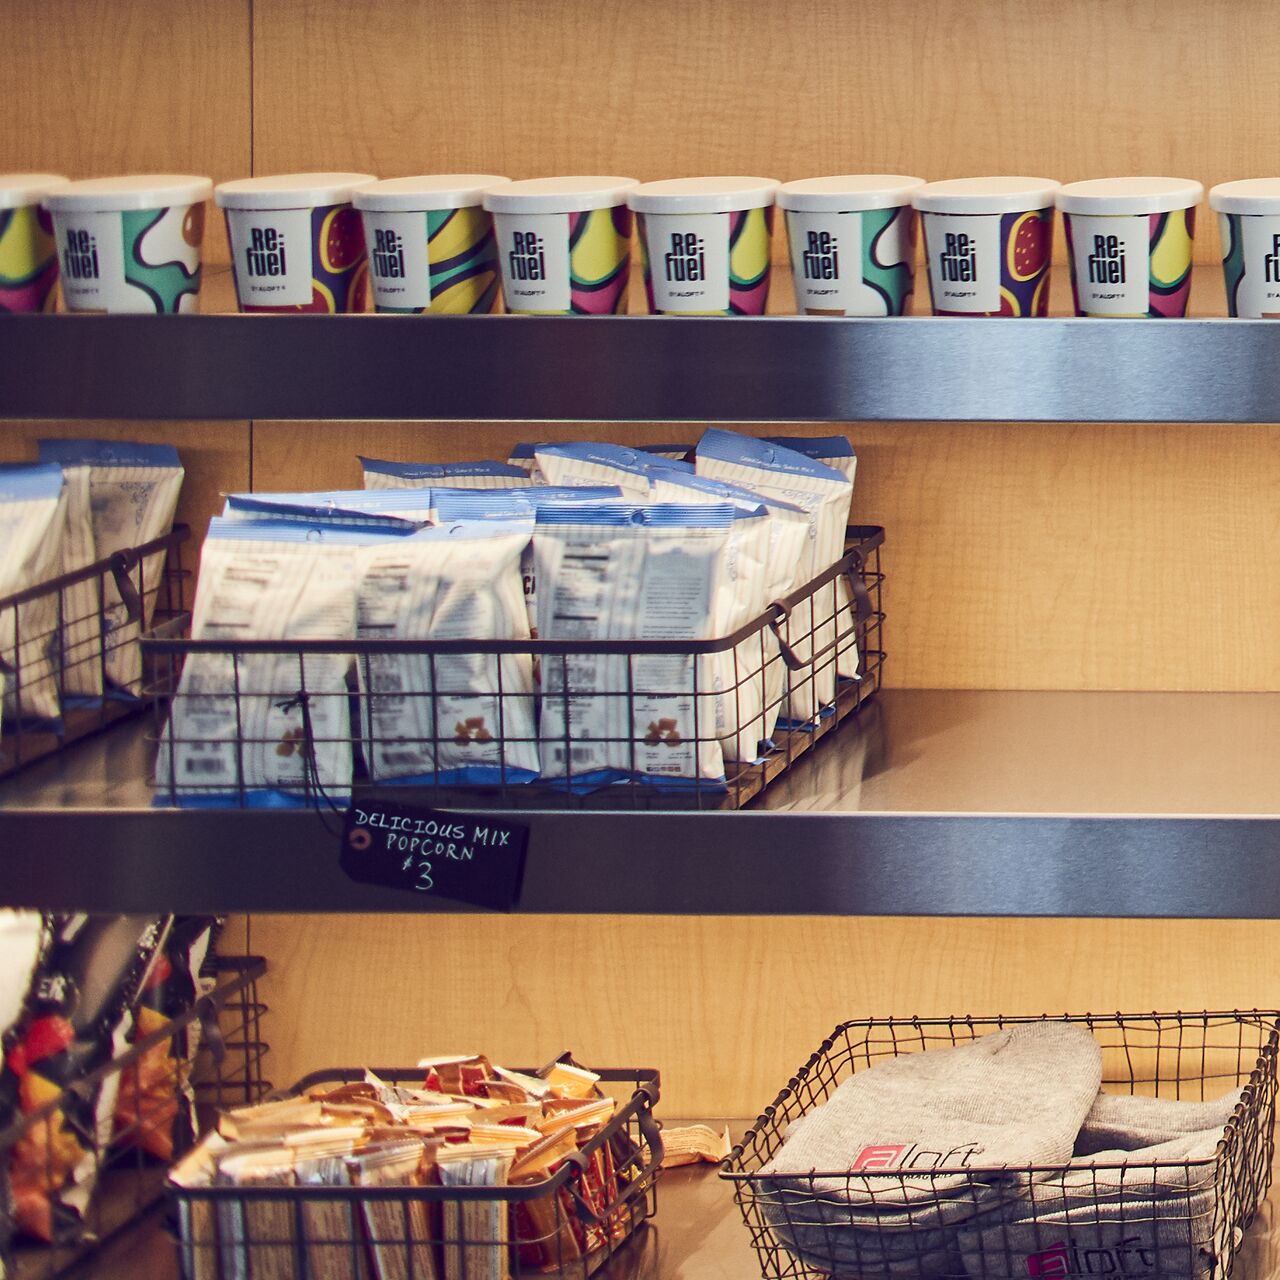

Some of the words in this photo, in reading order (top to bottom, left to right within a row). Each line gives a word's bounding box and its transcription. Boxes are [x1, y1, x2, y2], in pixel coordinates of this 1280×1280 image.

[670, 232, 704, 258] Re:
[665, 252, 706, 282] fuel
[355, 808, 465, 839] DELICIOUS
[473, 826, 511, 847] MIX
[387, 833, 474, 860] POPCORN
[851, 1142, 984, 1169] aloft
